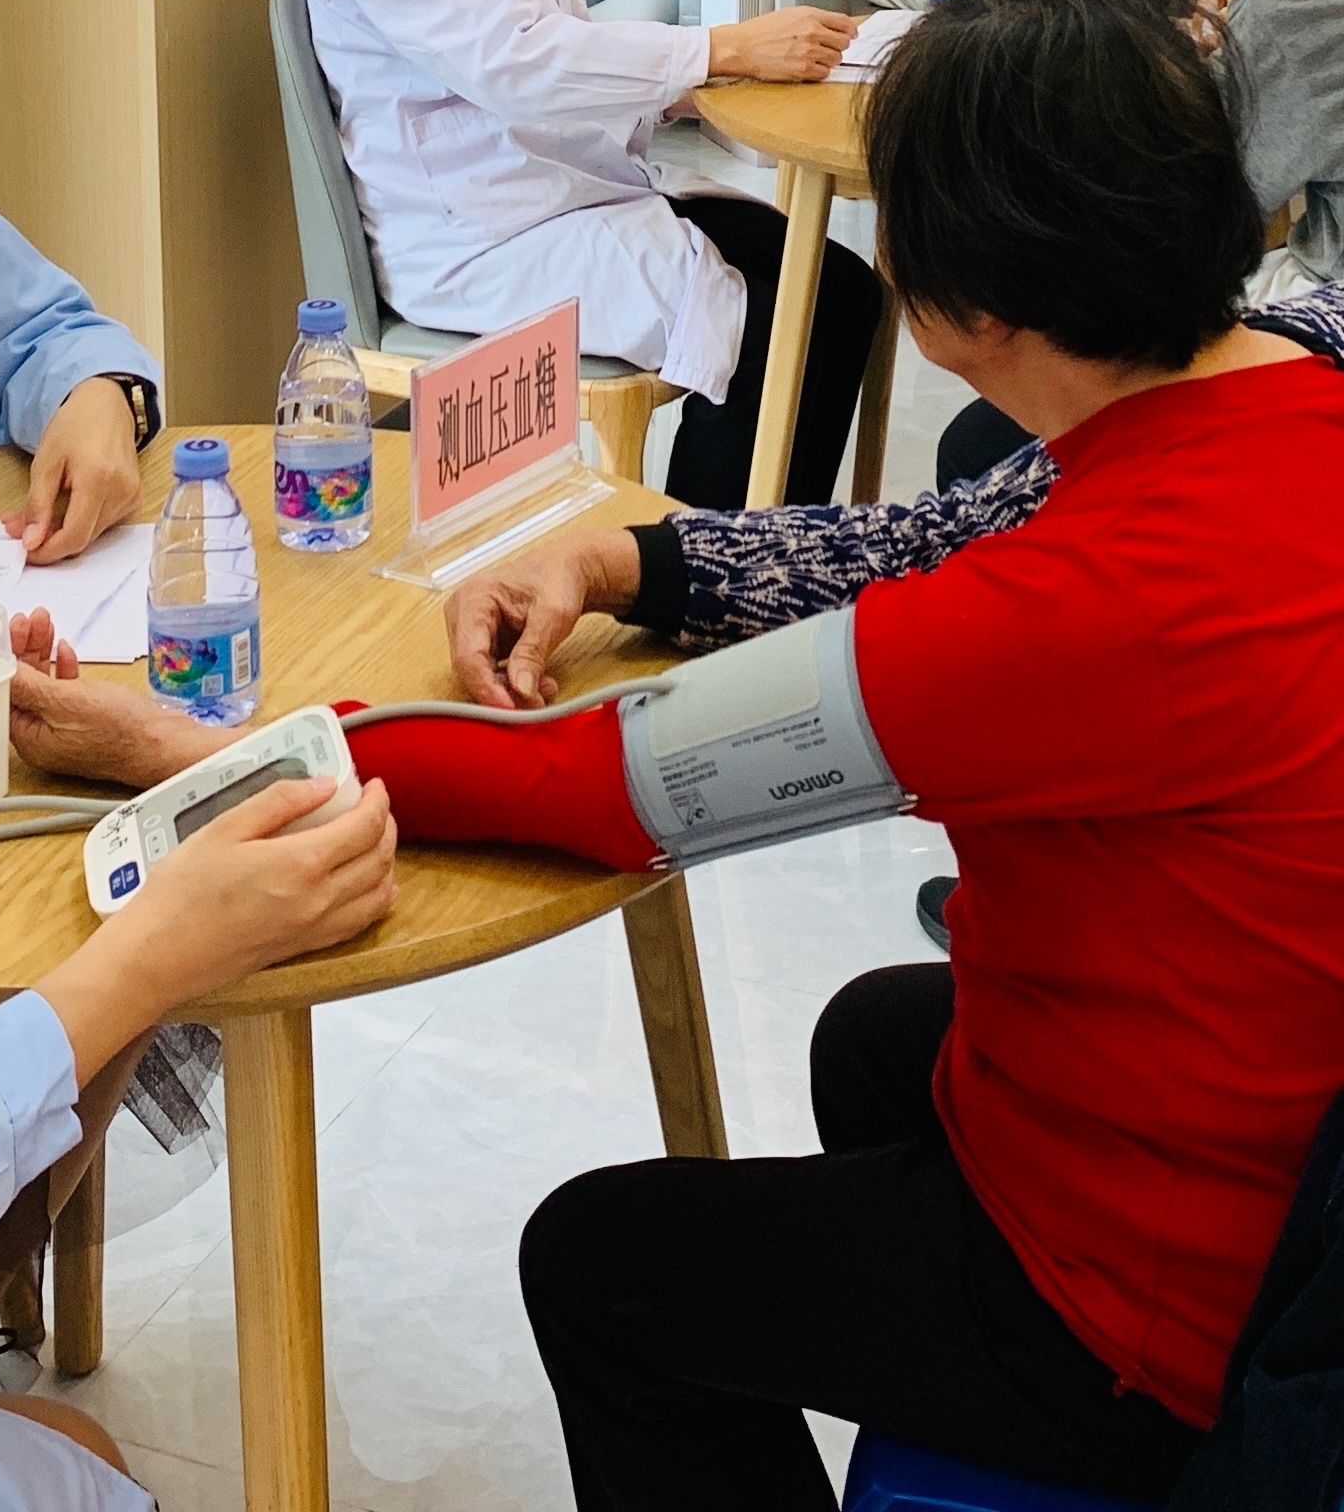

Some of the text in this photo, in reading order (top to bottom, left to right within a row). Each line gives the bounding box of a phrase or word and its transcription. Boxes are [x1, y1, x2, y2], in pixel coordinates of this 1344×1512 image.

[437, 341, 557, 490] 测血压血糖
